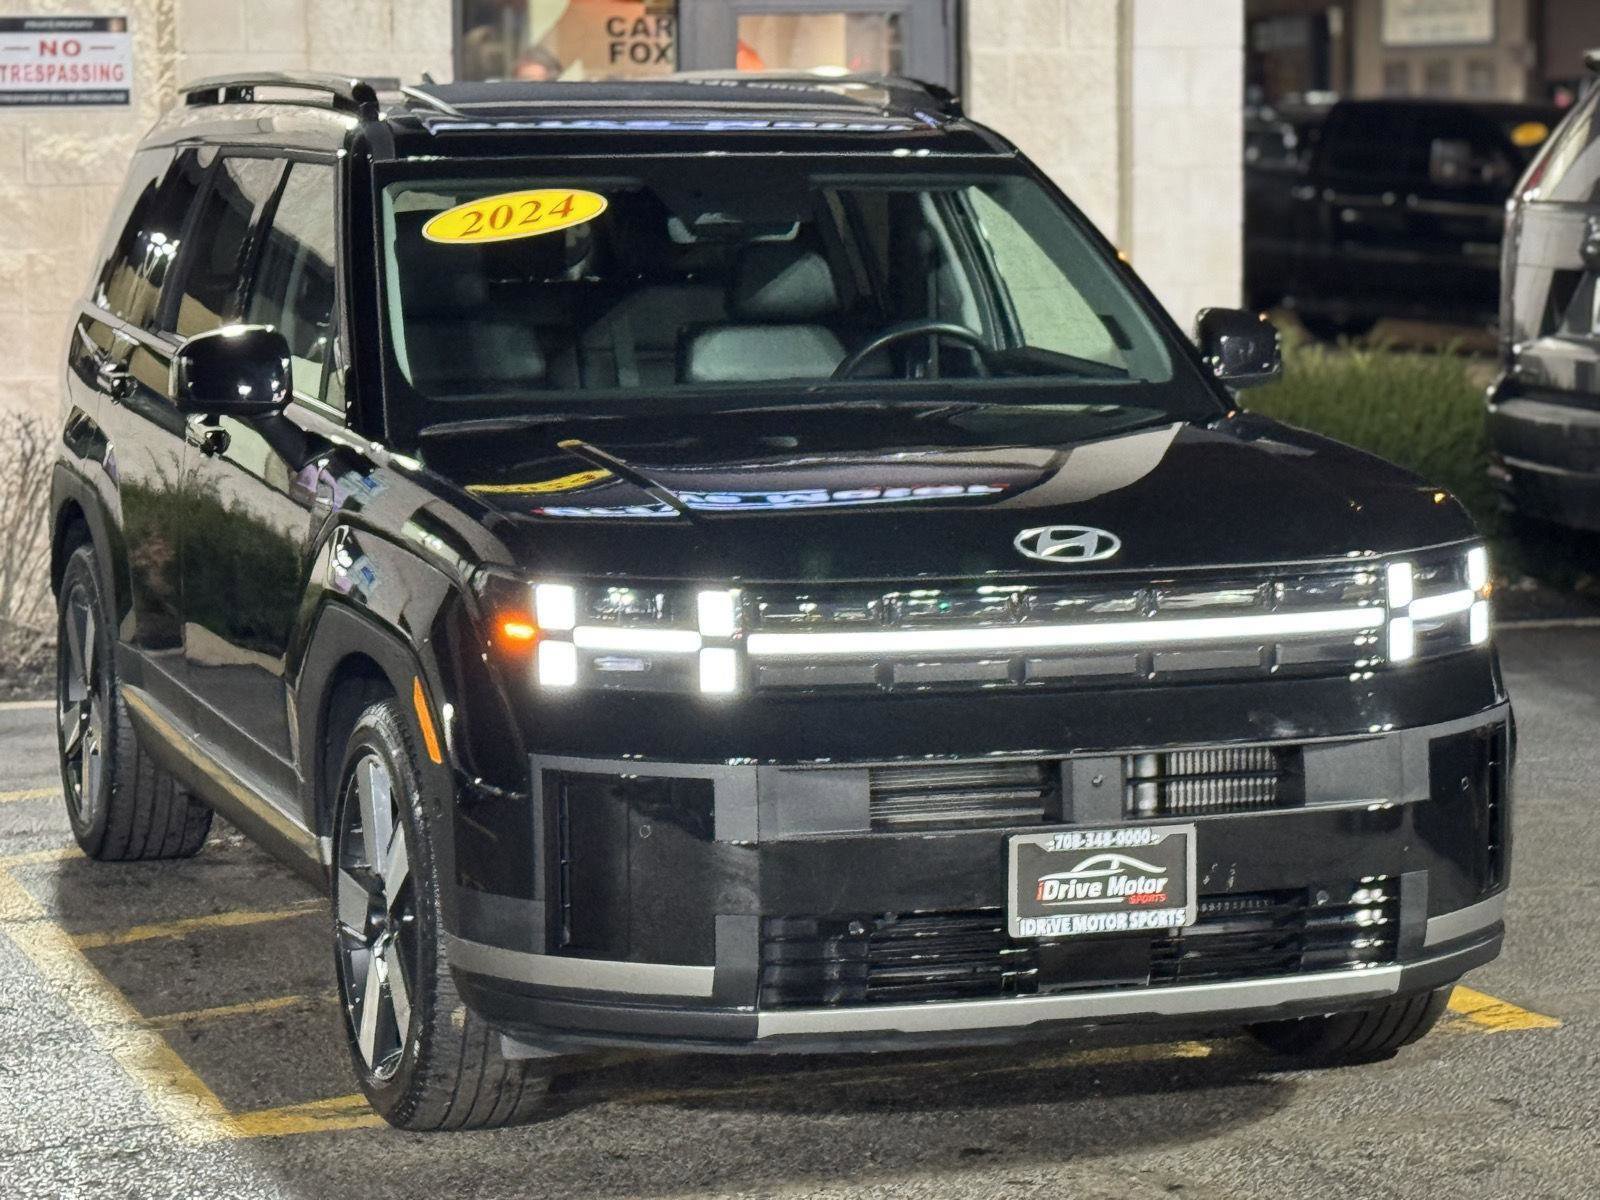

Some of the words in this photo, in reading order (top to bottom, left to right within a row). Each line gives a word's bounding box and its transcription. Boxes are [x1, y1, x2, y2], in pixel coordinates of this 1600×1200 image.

[606, 15, 673, 38] CAR
[38, 40, 82, 57] NO
[609, 41, 674, 65] FOX
[0, 64, 125, 82] TRESPASSING
[458, 194, 575, 238] 2024
[1036, 879, 1102, 902] iDrive
[1107, 876, 1168, 897] Motor
[1128, 894, 1168, 904] SPORTS
[1072, 914, 1129, 933] MOTOR
[1129, 910, 1187, 928] SPORTS
